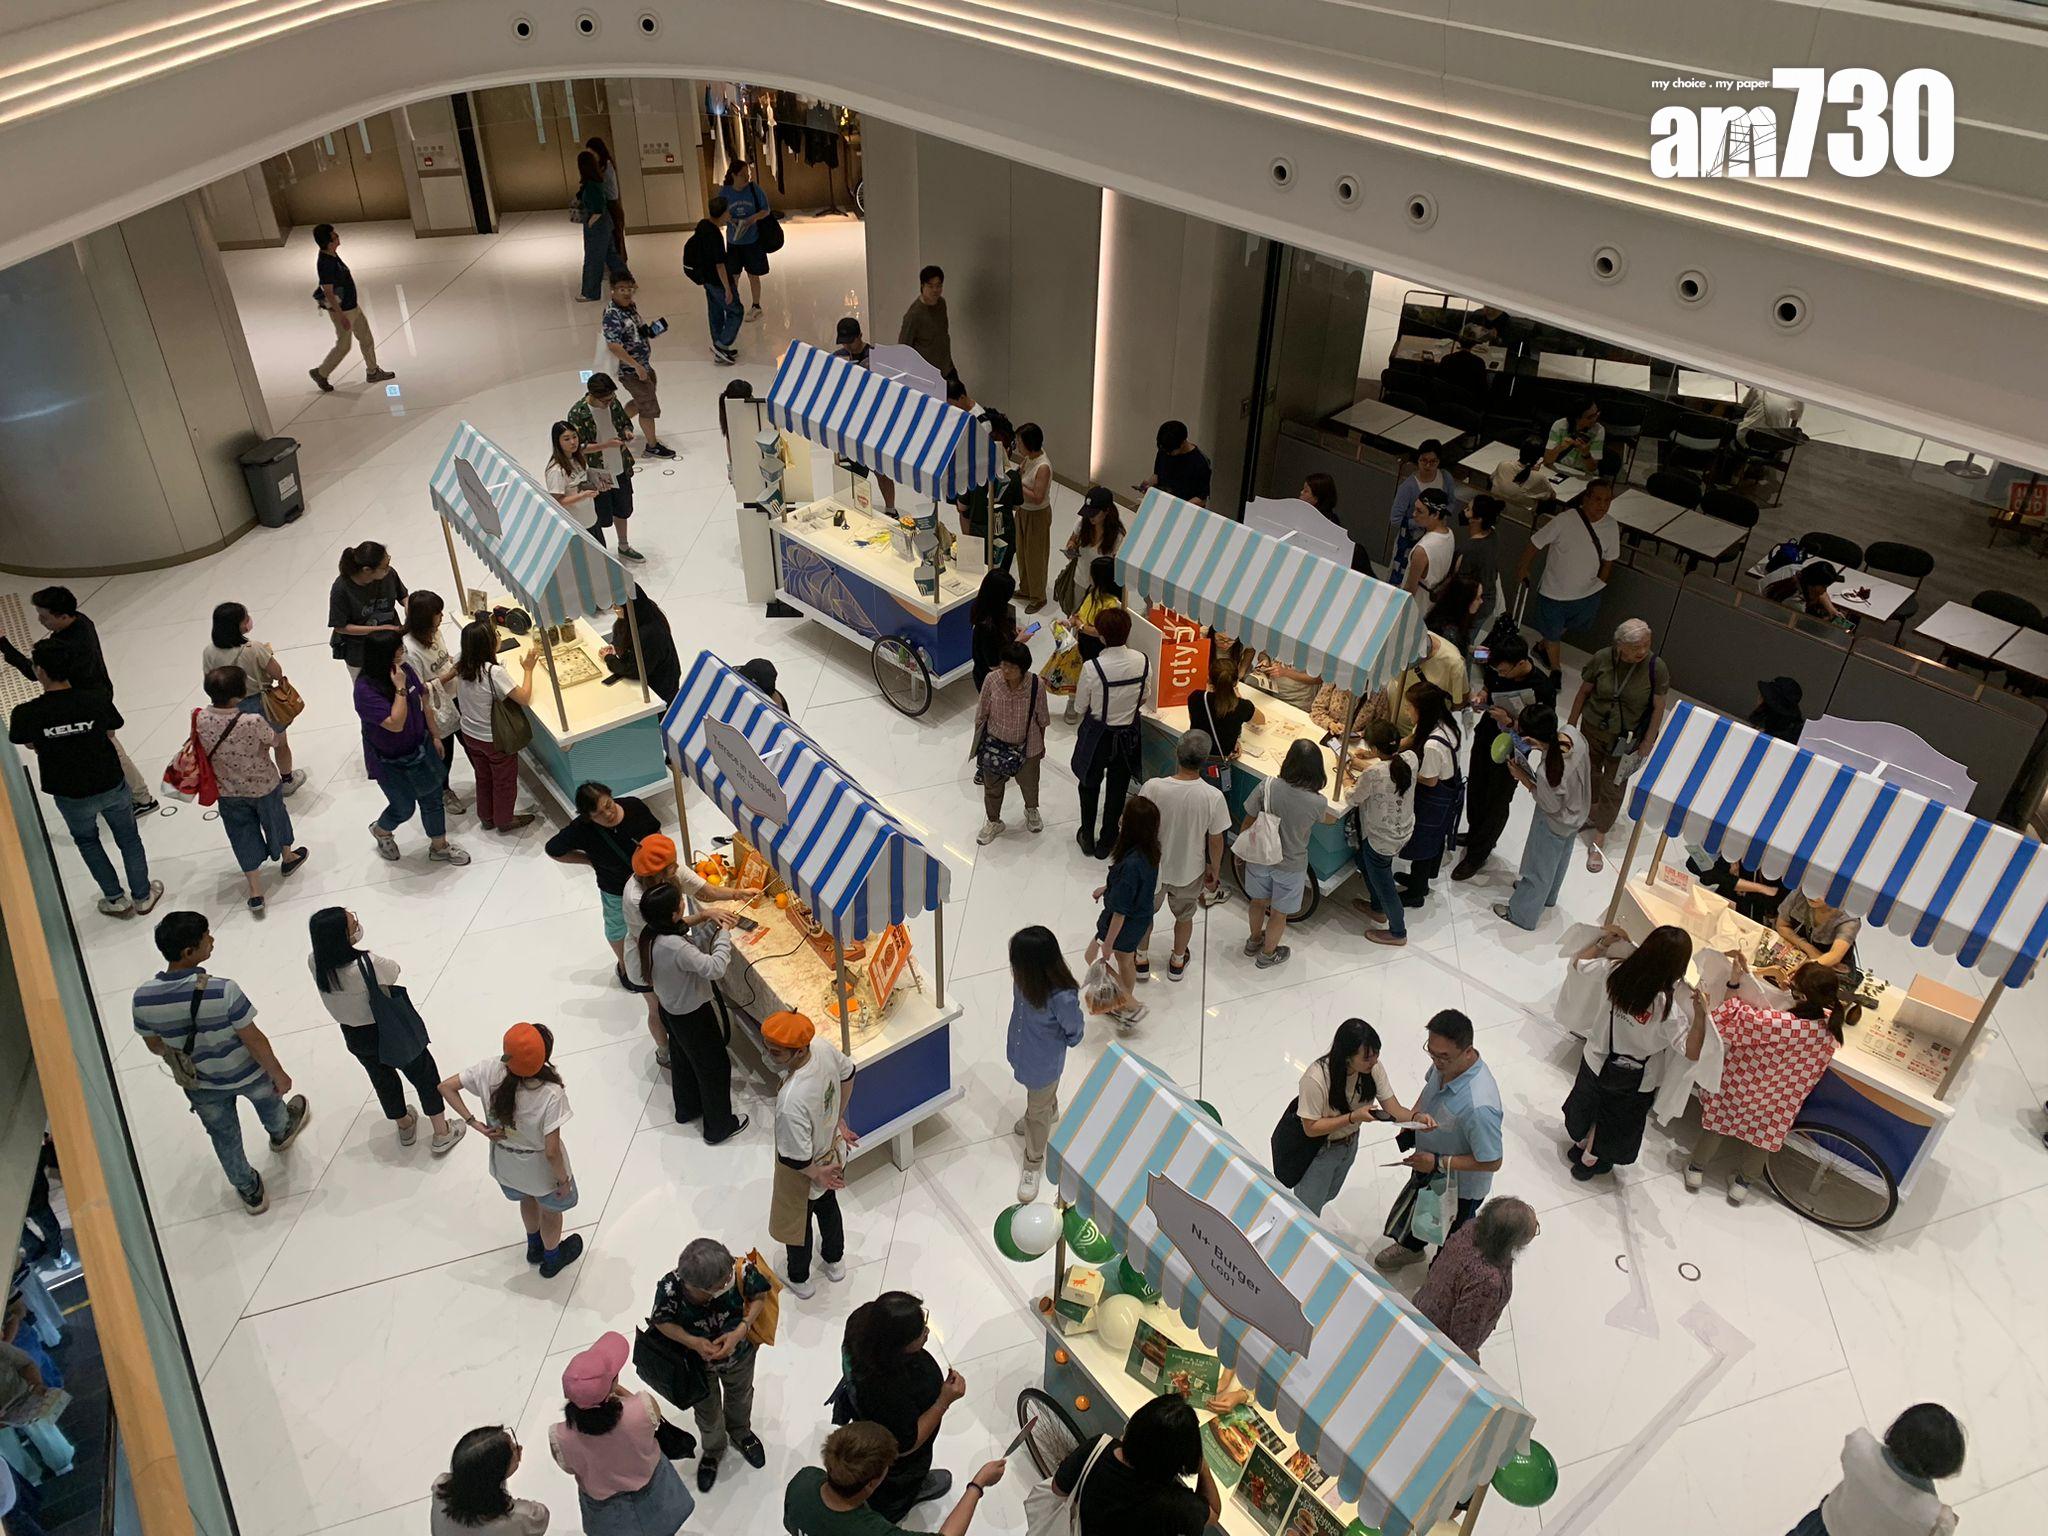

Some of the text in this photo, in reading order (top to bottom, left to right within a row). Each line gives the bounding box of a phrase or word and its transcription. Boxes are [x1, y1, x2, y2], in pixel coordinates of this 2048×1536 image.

[1170, 645, 1198, 687] city
[43, 720, 95, 737] KELTY
[1191, 1223, 1262, 1295] N+ Burger
[1210, 1259, 1235, 1287] LG01
